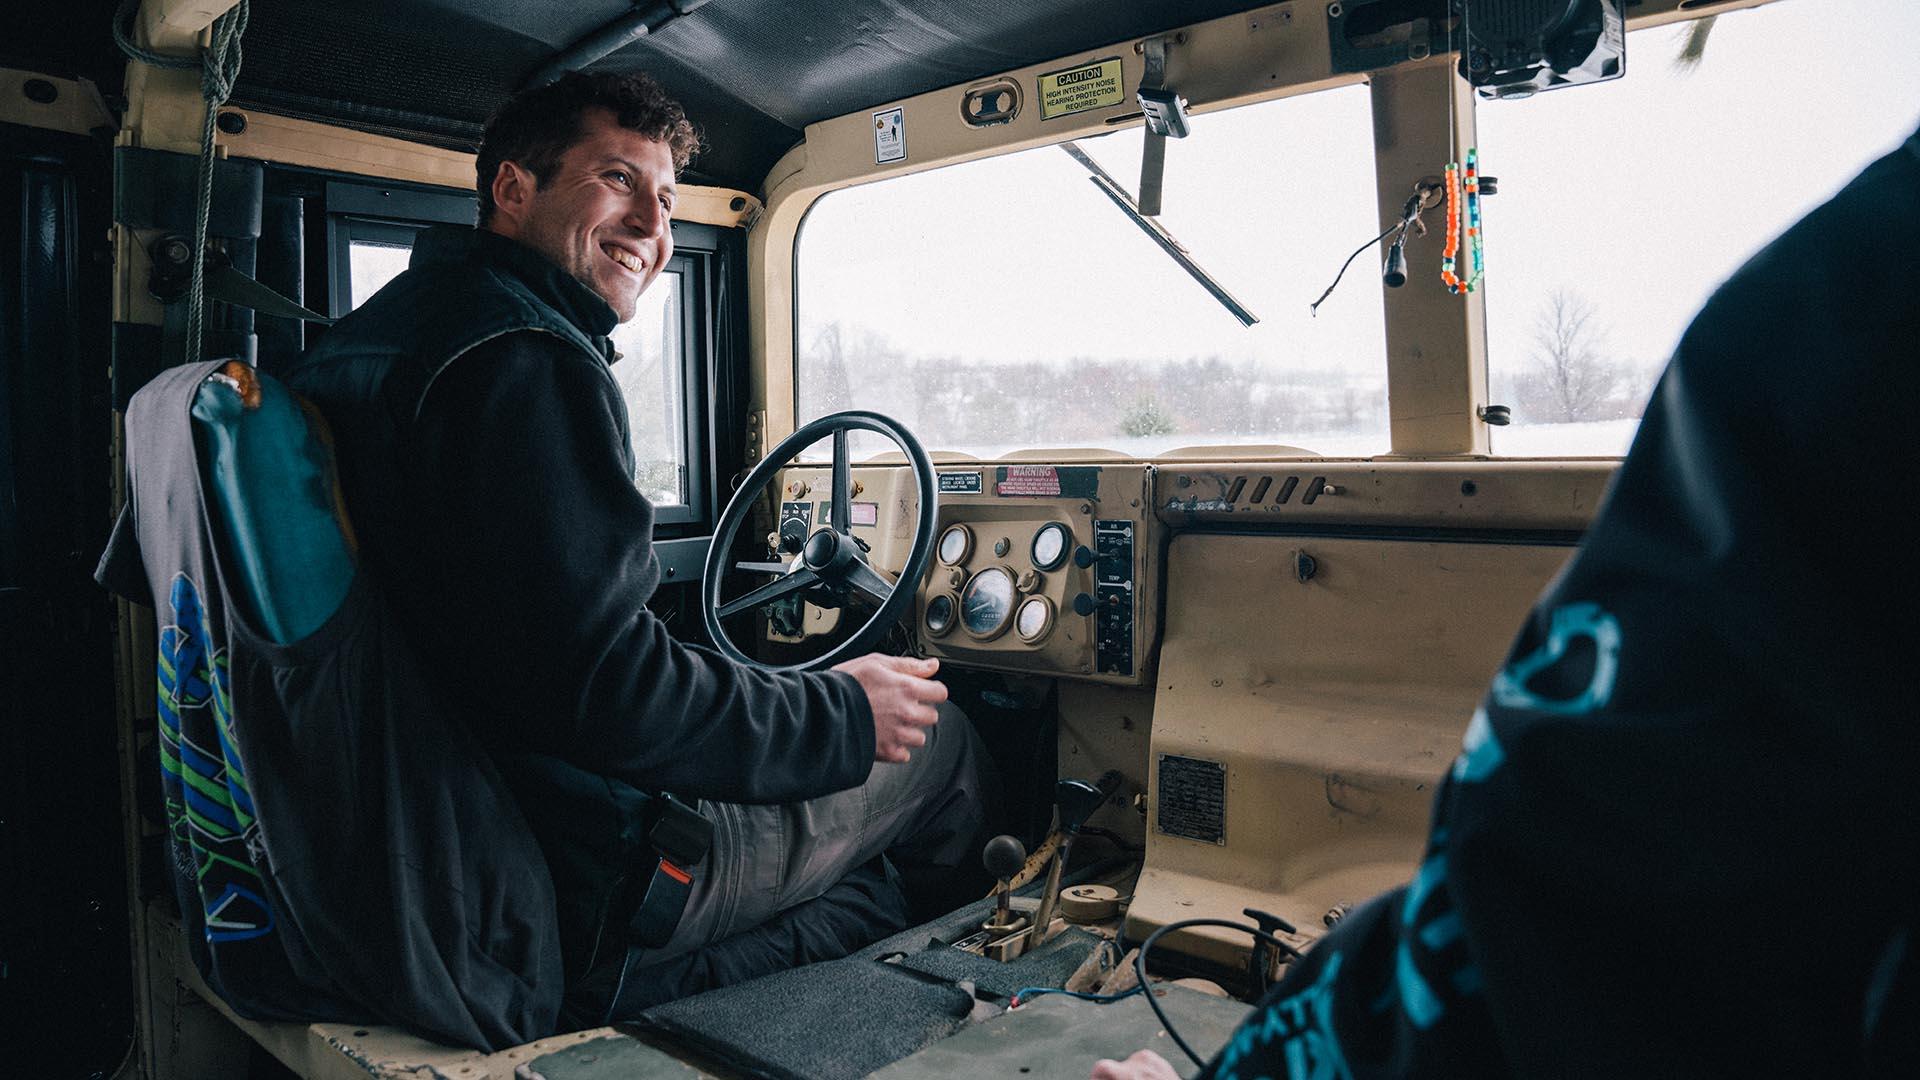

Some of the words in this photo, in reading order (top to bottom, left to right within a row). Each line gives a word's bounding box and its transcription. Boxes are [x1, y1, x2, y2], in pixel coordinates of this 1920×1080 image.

[1059, 68, 1101, 85] CAUTION
[1046, 90, 1062, 98] HIGH
[1063, 83, 1095, 95] INTENSITY
[1096, 78, 1115, 88] NOISE
[1046, 96, 1074, 107] HEARING
[1075, 87, 1116, 100] PROTECTION
[1065, 98, 1098, 110] REQUIRED
[1013, 466, 1051, 477] WARNING
